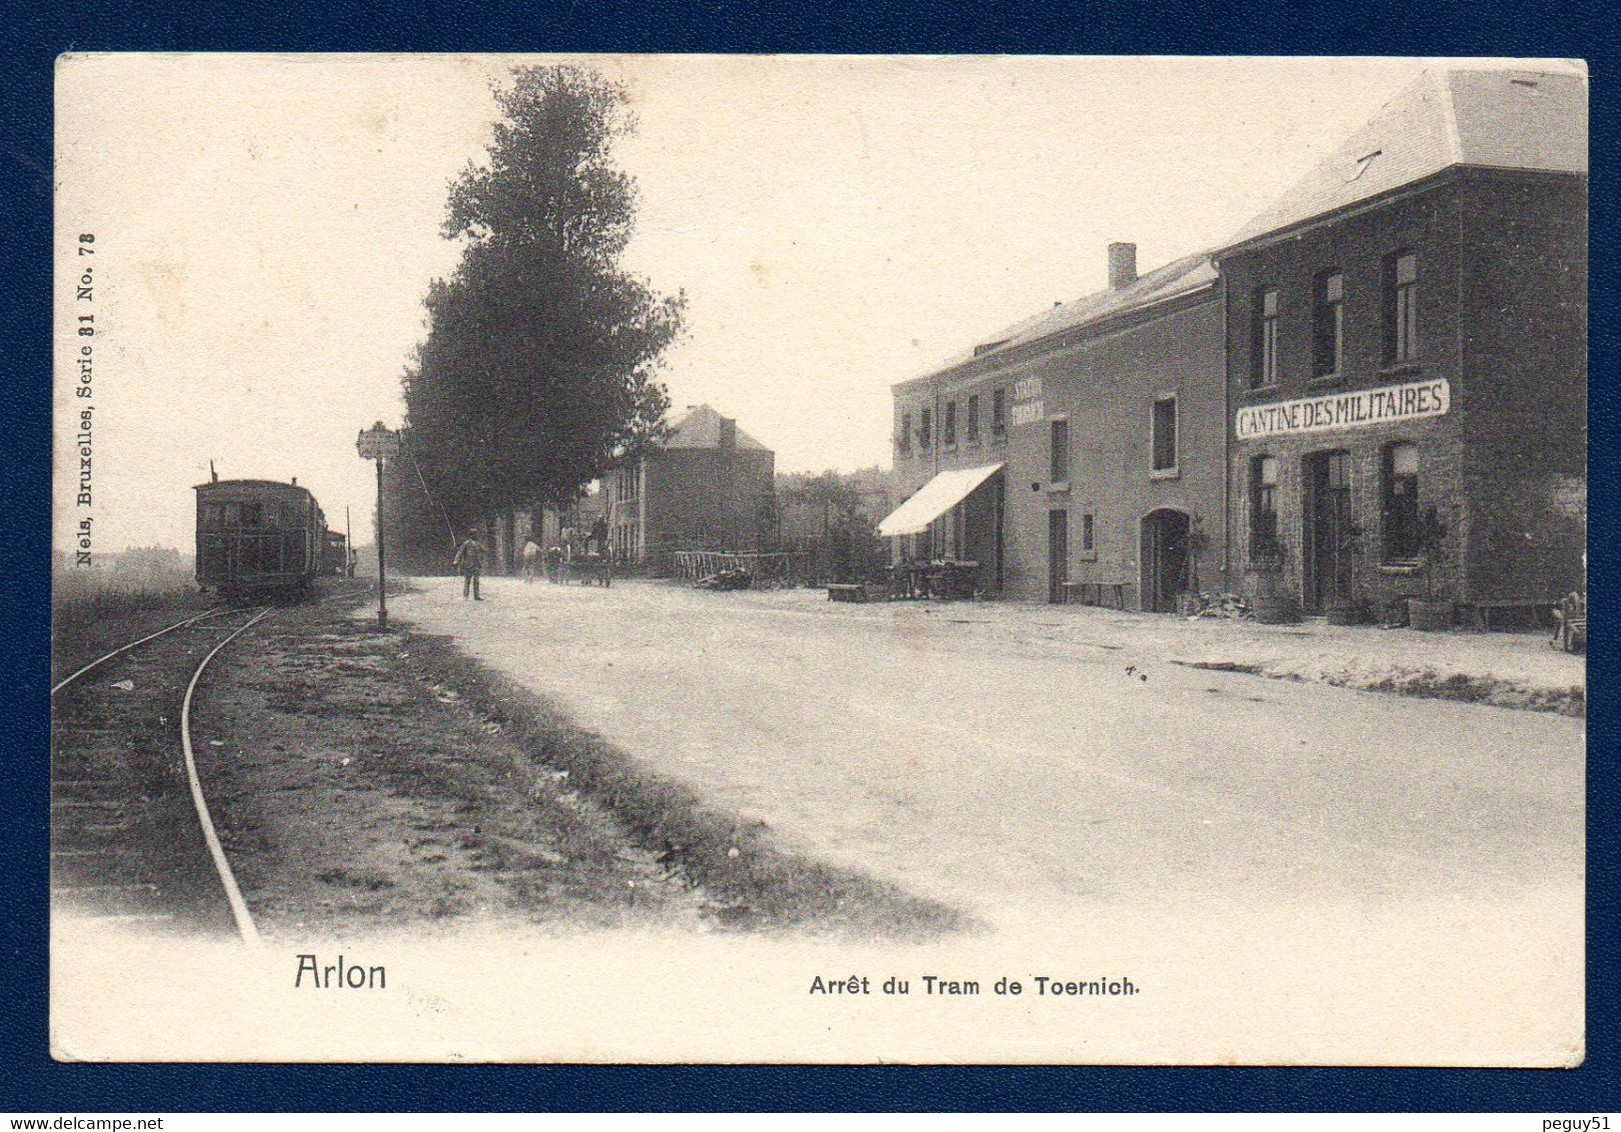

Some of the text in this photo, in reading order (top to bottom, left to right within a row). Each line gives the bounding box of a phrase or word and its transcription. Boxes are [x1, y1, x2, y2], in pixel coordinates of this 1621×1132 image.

[1240, 384, 1443, 435] CANTINE DES MILITAIRES
